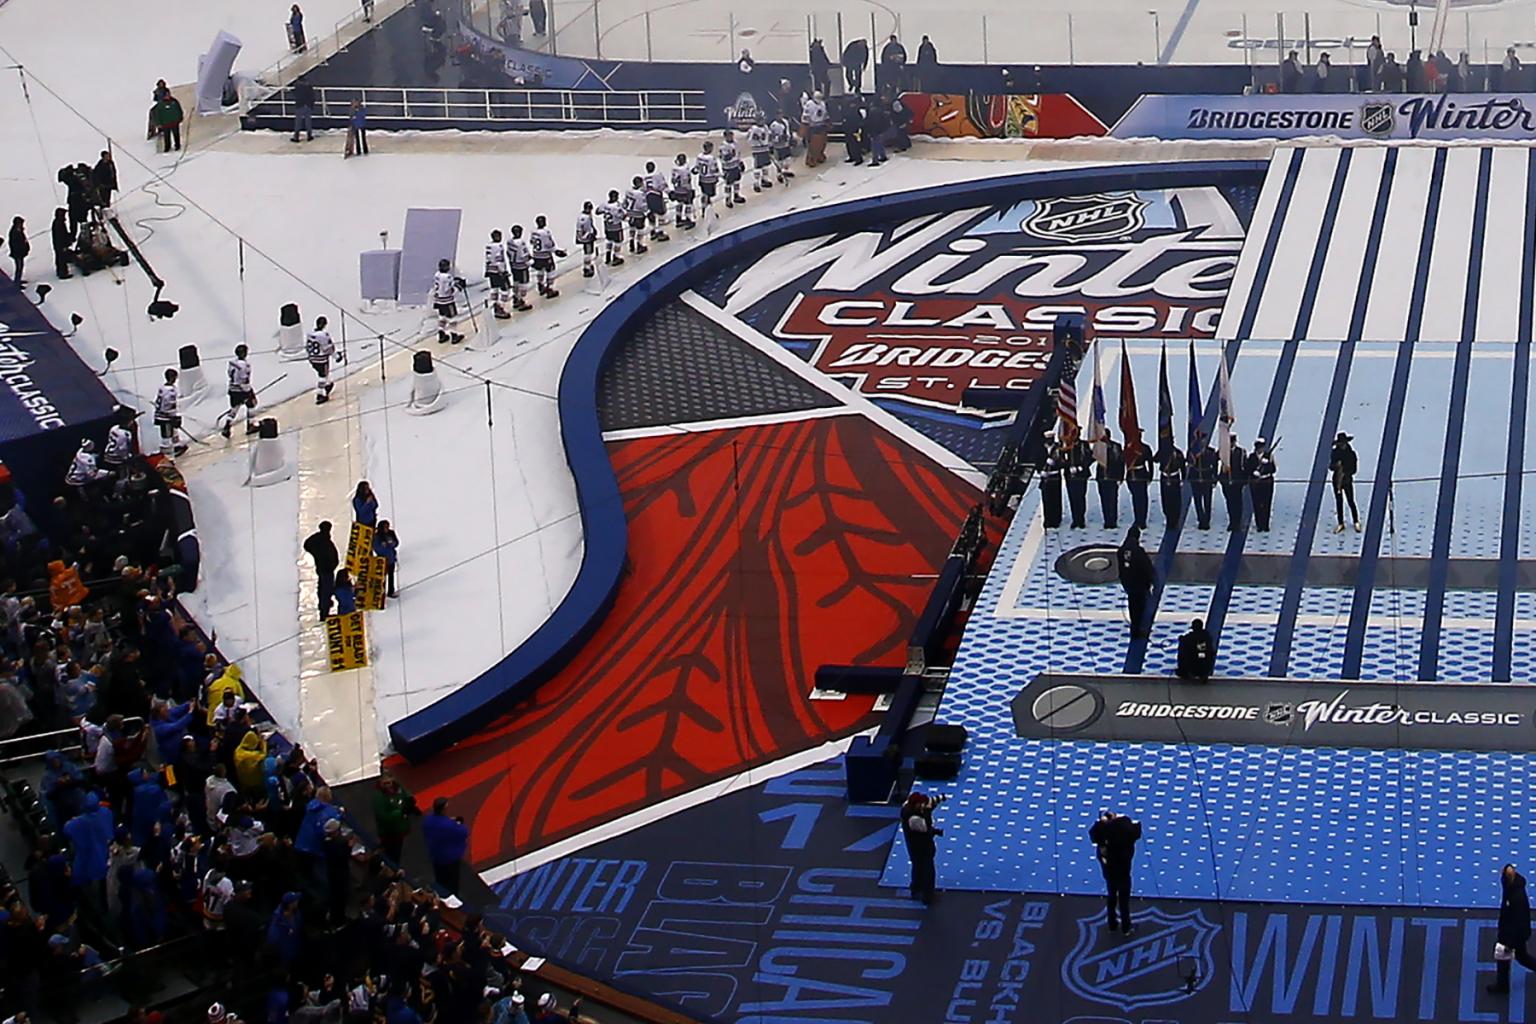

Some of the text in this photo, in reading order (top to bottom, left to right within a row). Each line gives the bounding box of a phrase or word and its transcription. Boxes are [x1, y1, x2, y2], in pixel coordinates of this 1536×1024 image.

[1189, 110, 1353, 130] BRIDGESTONE
[1399, 96, 1536, 139] Winter
[1046, 202, 1125, 232] NHL
[5, 374, 66, 431] CLASSIC
[326, 617, 343, 655] STUNT
[350, 613, 366, 665] GET READY
[1115, 700, 1258, 721] BRIDGESTONE
[1296, 688, 1414, 732] Winter
[1414, 711, 1522, 726] CLASSIC
[1095, 935, 1187, 983] NHL
